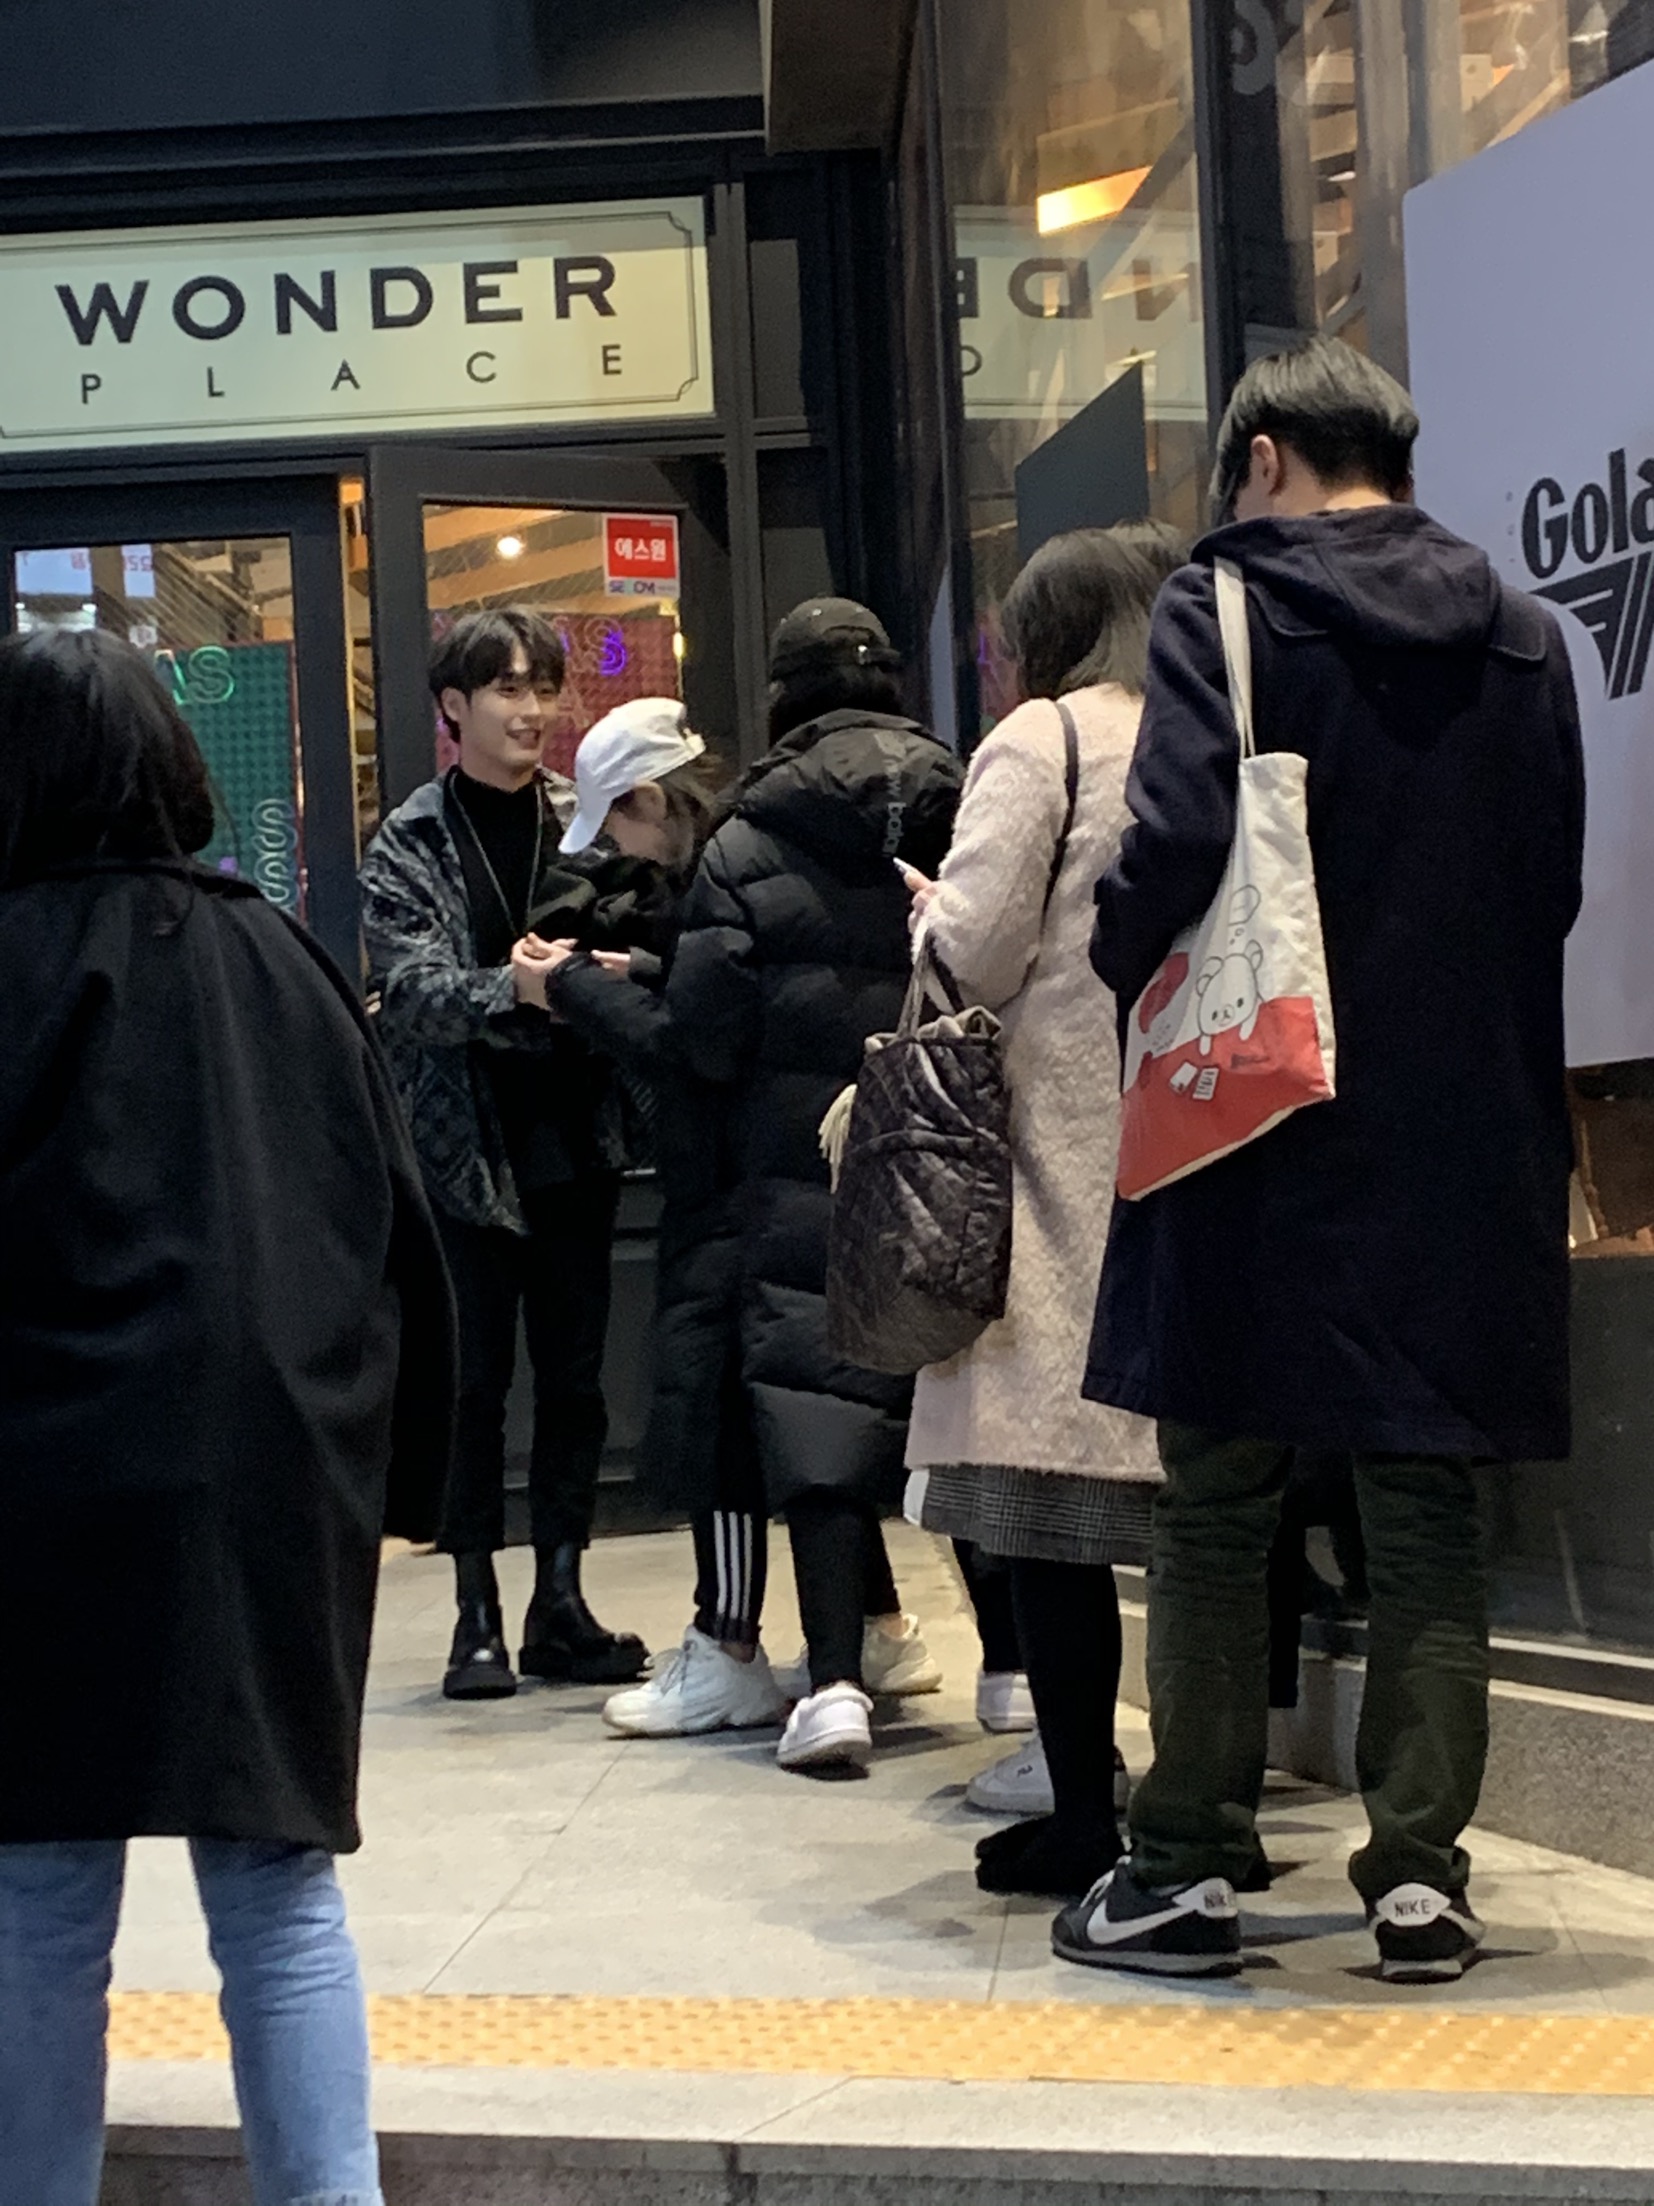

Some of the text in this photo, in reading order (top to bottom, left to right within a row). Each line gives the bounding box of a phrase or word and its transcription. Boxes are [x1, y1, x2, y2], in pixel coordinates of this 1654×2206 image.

[54, 254, 618, 346] WONDER
[80, 343, 623, 405] PLACE
[1521, 446, 1654, 580] Gola
[613, 536, 667, 562] 에스원
[1394, 1898, 1431, 1917] NIKE
